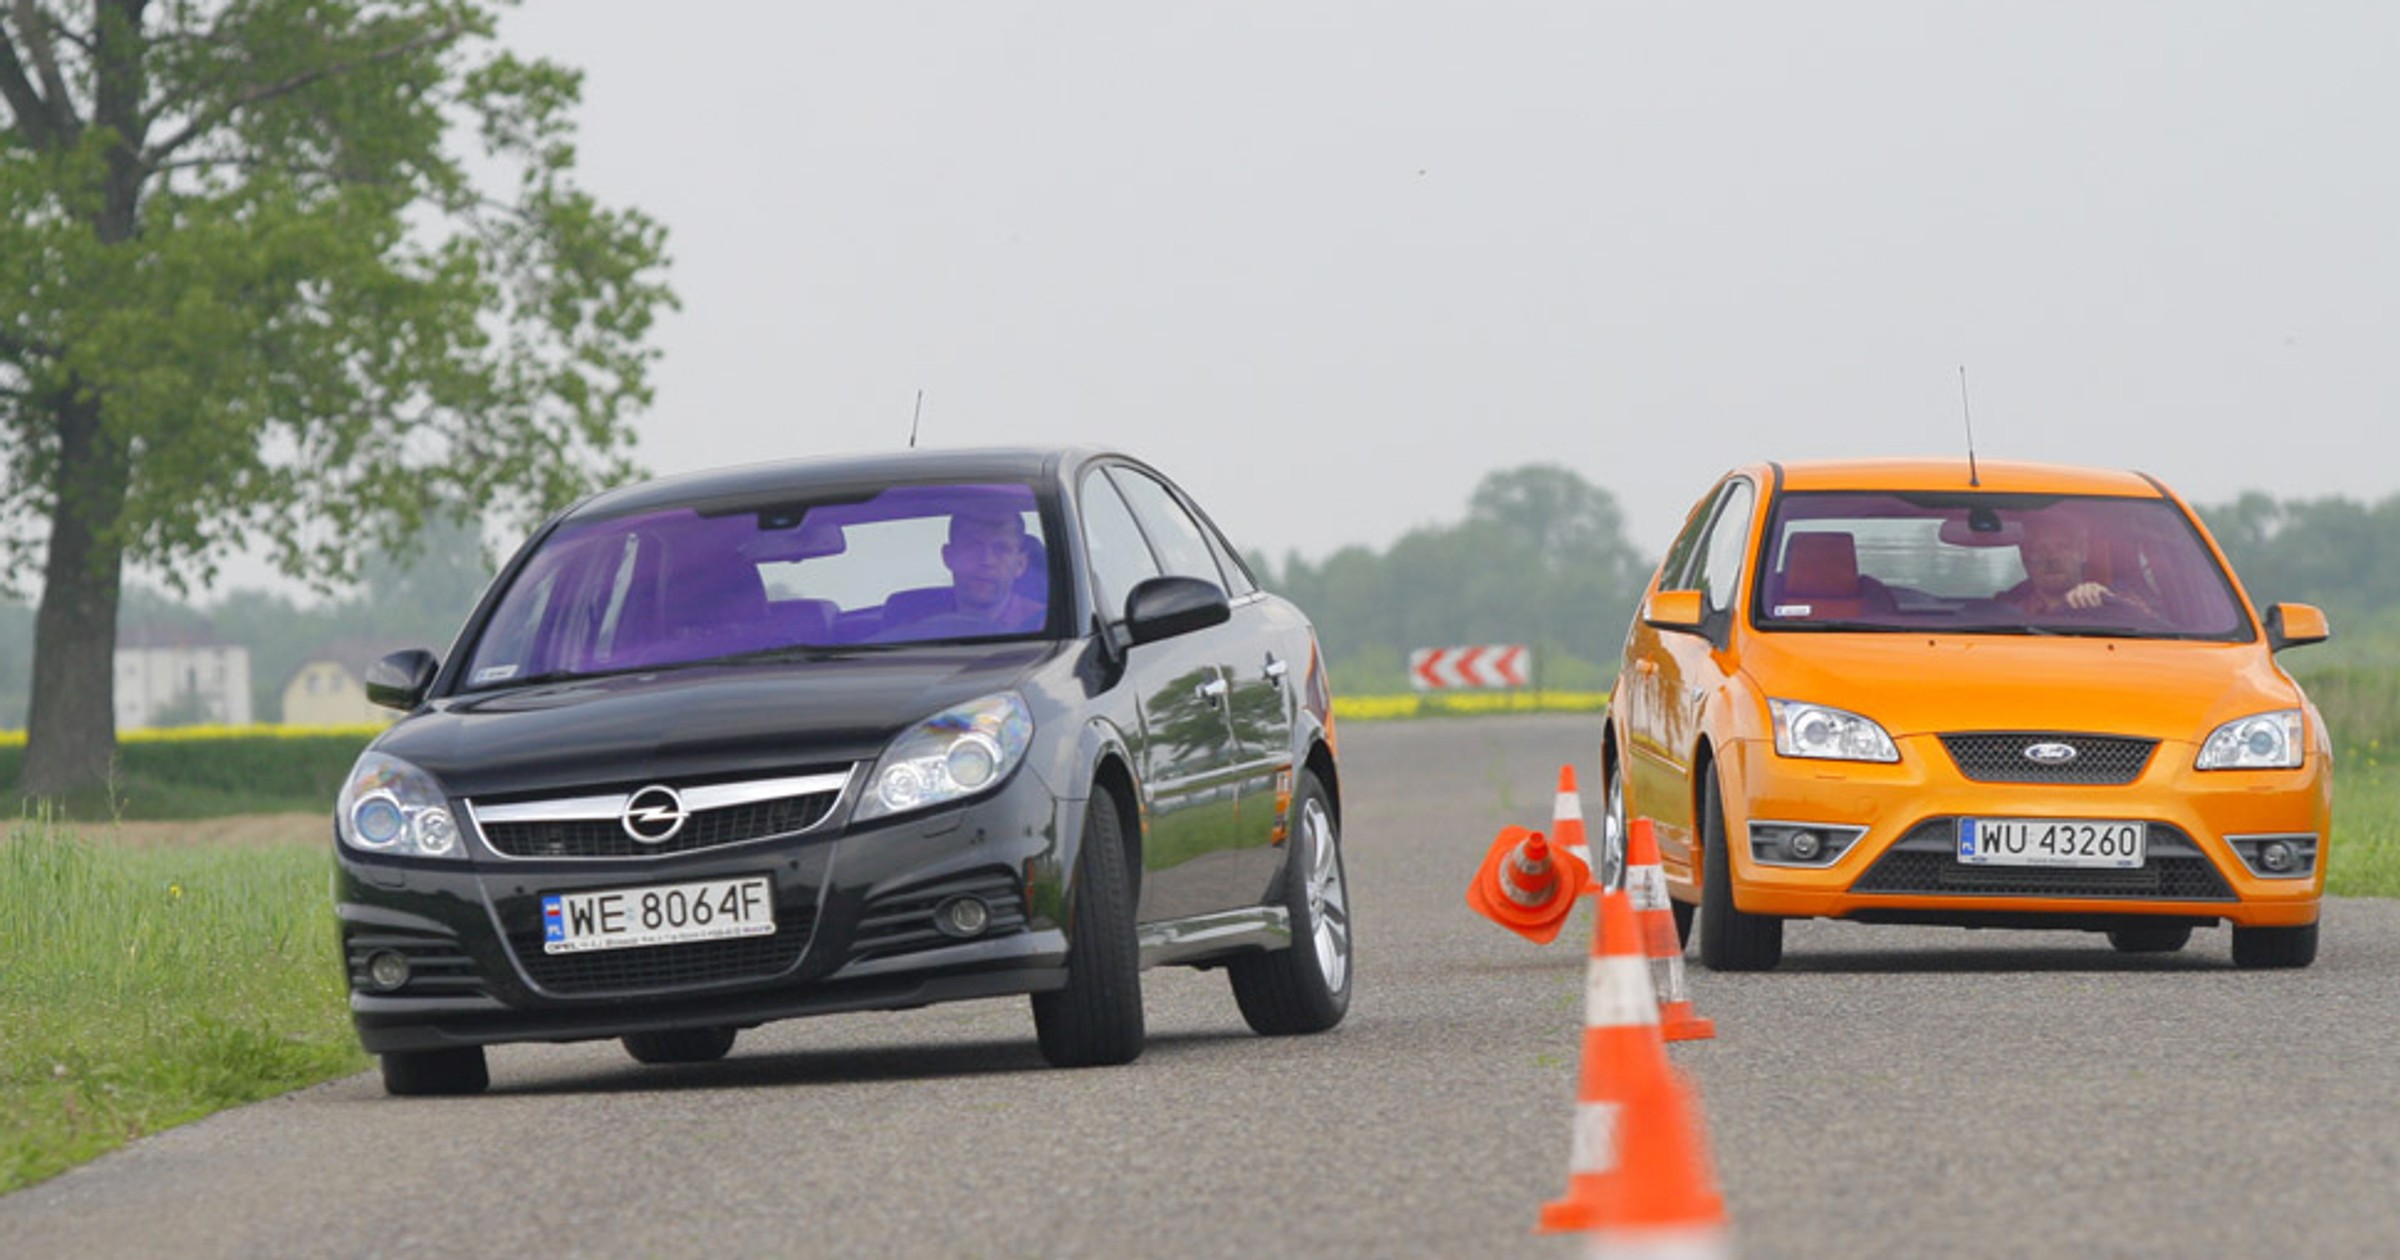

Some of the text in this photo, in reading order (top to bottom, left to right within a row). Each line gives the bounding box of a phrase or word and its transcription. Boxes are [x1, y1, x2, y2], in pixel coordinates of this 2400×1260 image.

[1982, 825, 2137, 856] WU 43260
[569, 881, 763, 936] WE 8064F
